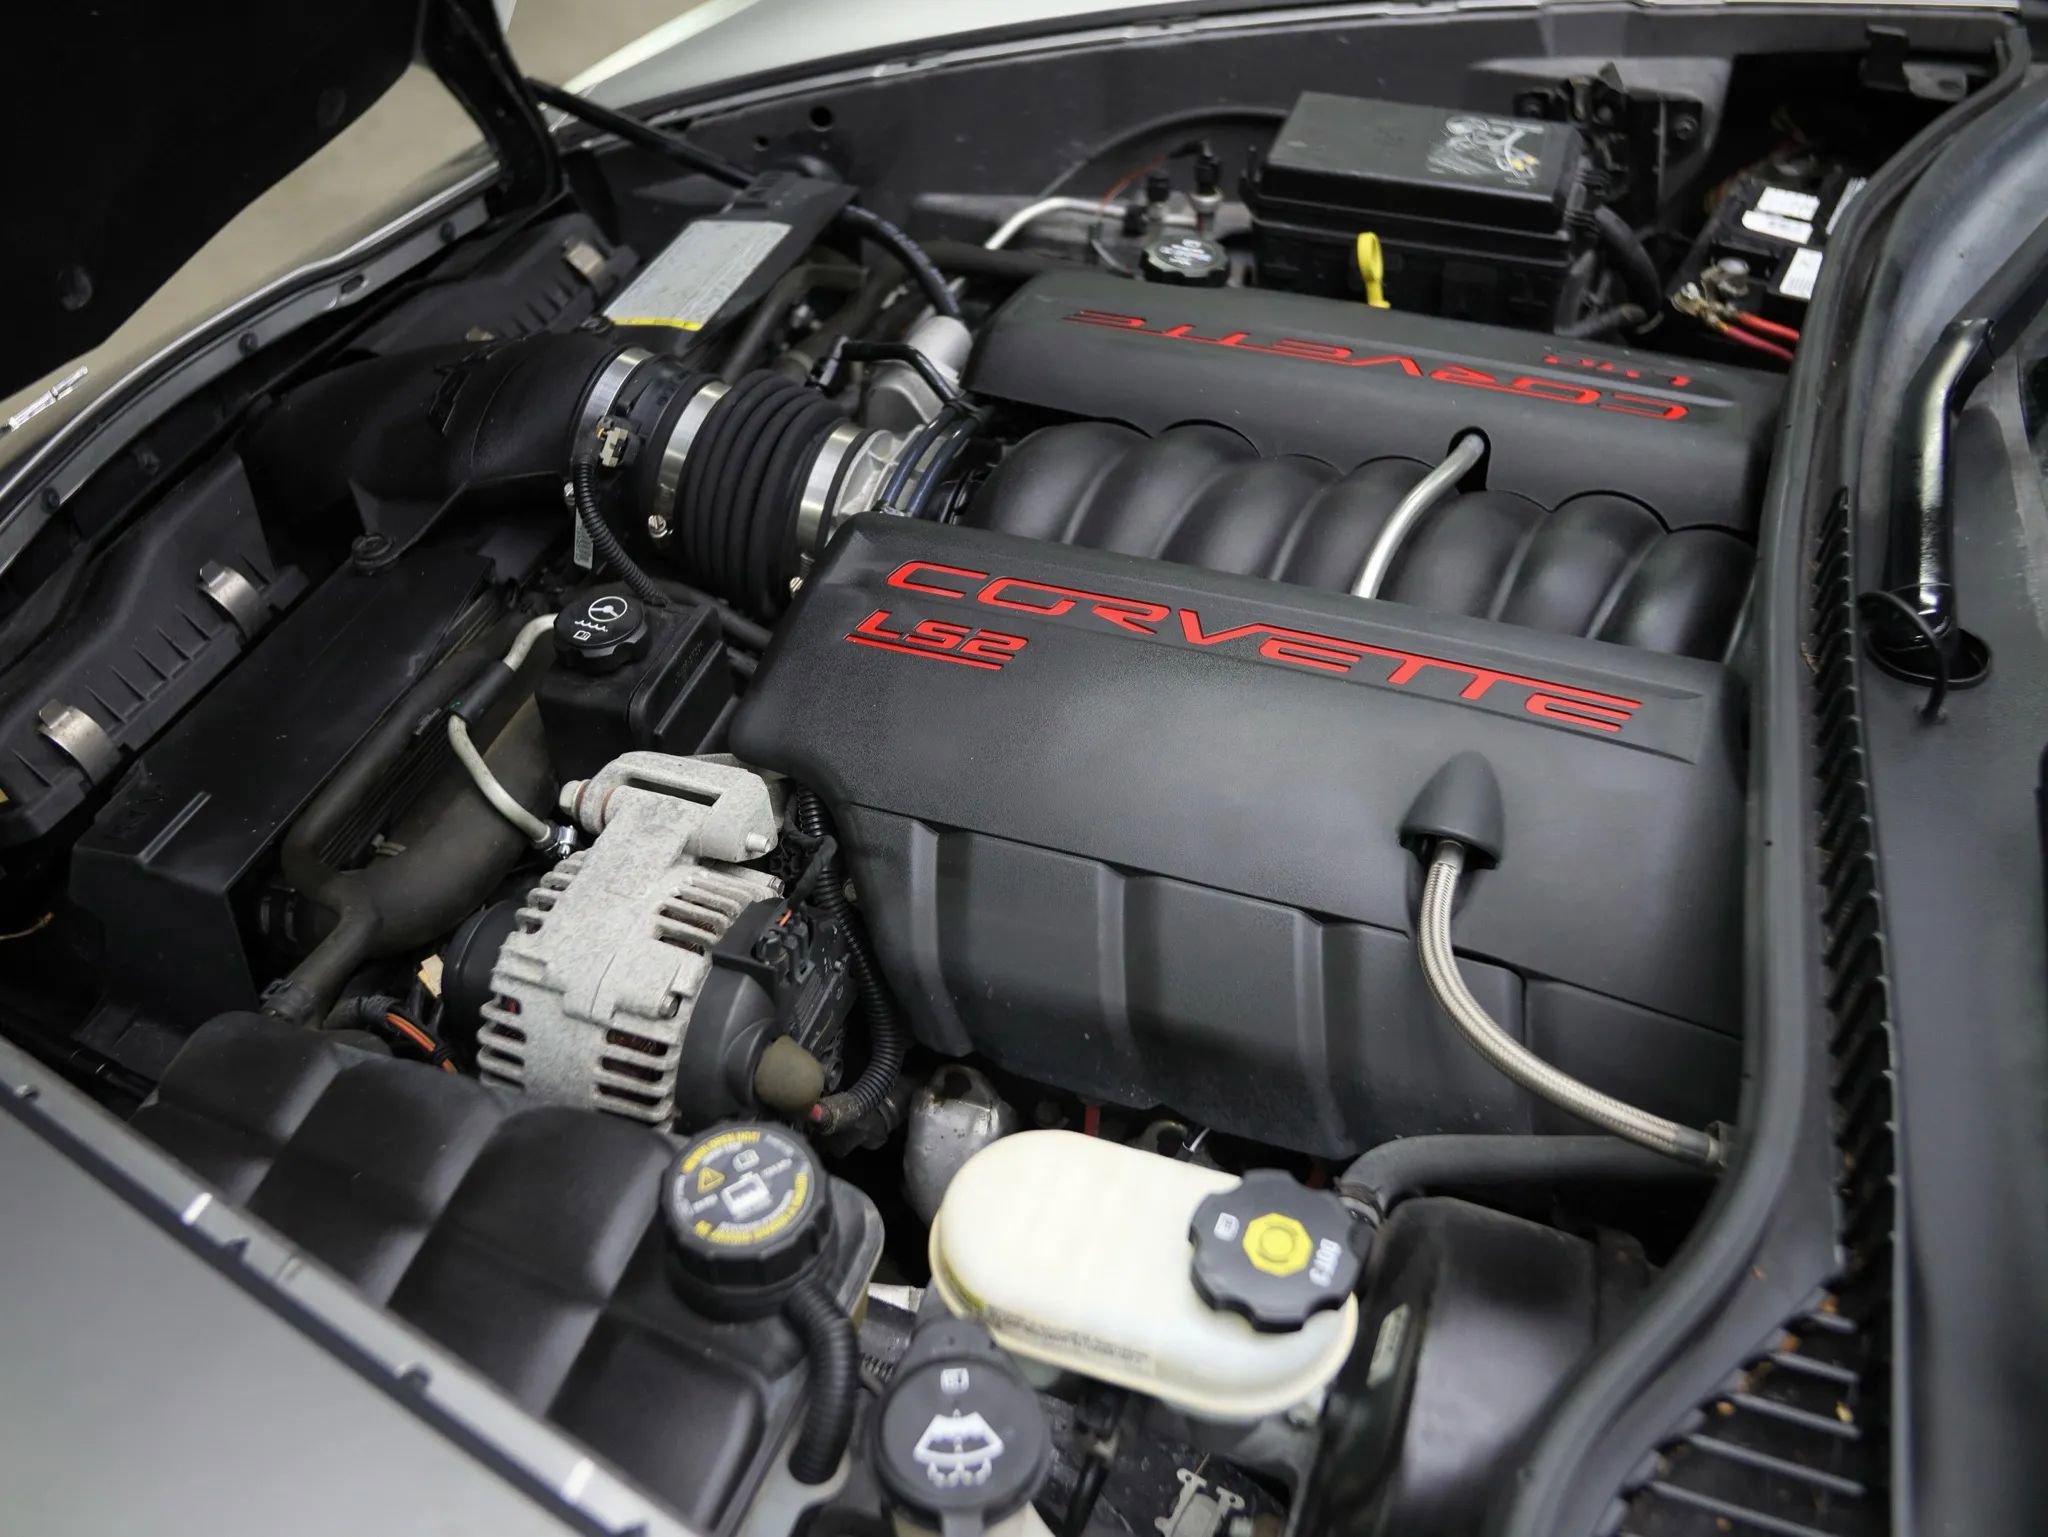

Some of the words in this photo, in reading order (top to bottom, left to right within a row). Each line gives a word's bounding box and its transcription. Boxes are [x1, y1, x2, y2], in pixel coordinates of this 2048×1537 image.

[1064, 309, 1690, 421] CORVETTE
[846, 608, 1029, 670] LS2
[886, 560, 1643, 732] CORVETTE
